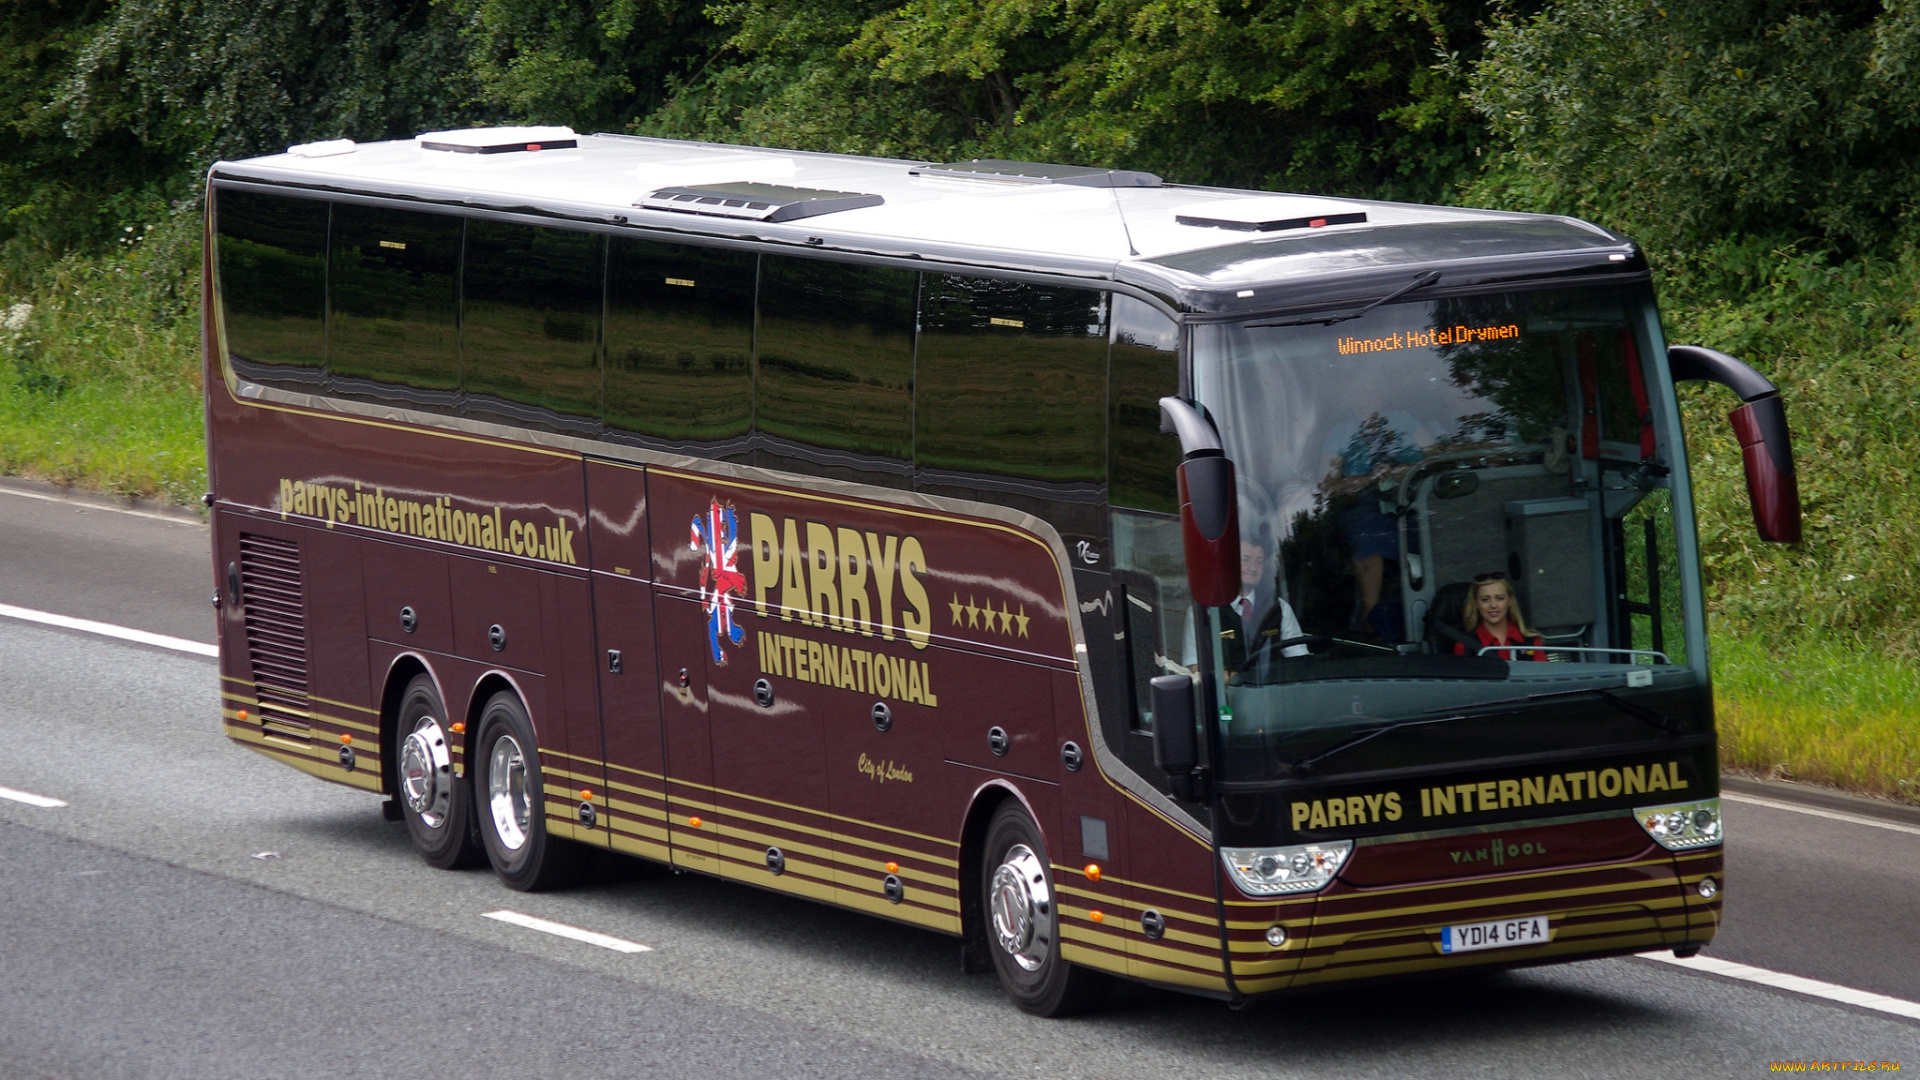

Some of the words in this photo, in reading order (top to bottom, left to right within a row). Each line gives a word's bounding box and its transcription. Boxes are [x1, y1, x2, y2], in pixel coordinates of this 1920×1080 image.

[1338, 332, 1404, 355] Winnock
[1406, 327, 1452, 348] Hotel
[1456, 324, 1519, 343] Drymen
[280, 477, 577, 566] parrys-international.co.uk
[750, 512, 931, 650] PARRYS
[757, 630, 938, 708] INTERNATIONAL
[858, 752, 875, 780] City
[876, 759, 885, 784] of
[885, 760, 913, 783] London
[1291, 791, 1403, 831] PARRYS
[1420, 762, 1689, 817] INTERNATIONAL
[1458, 924, 1500, 947] YD14
[1505, 919, 1541, 941] GFA
